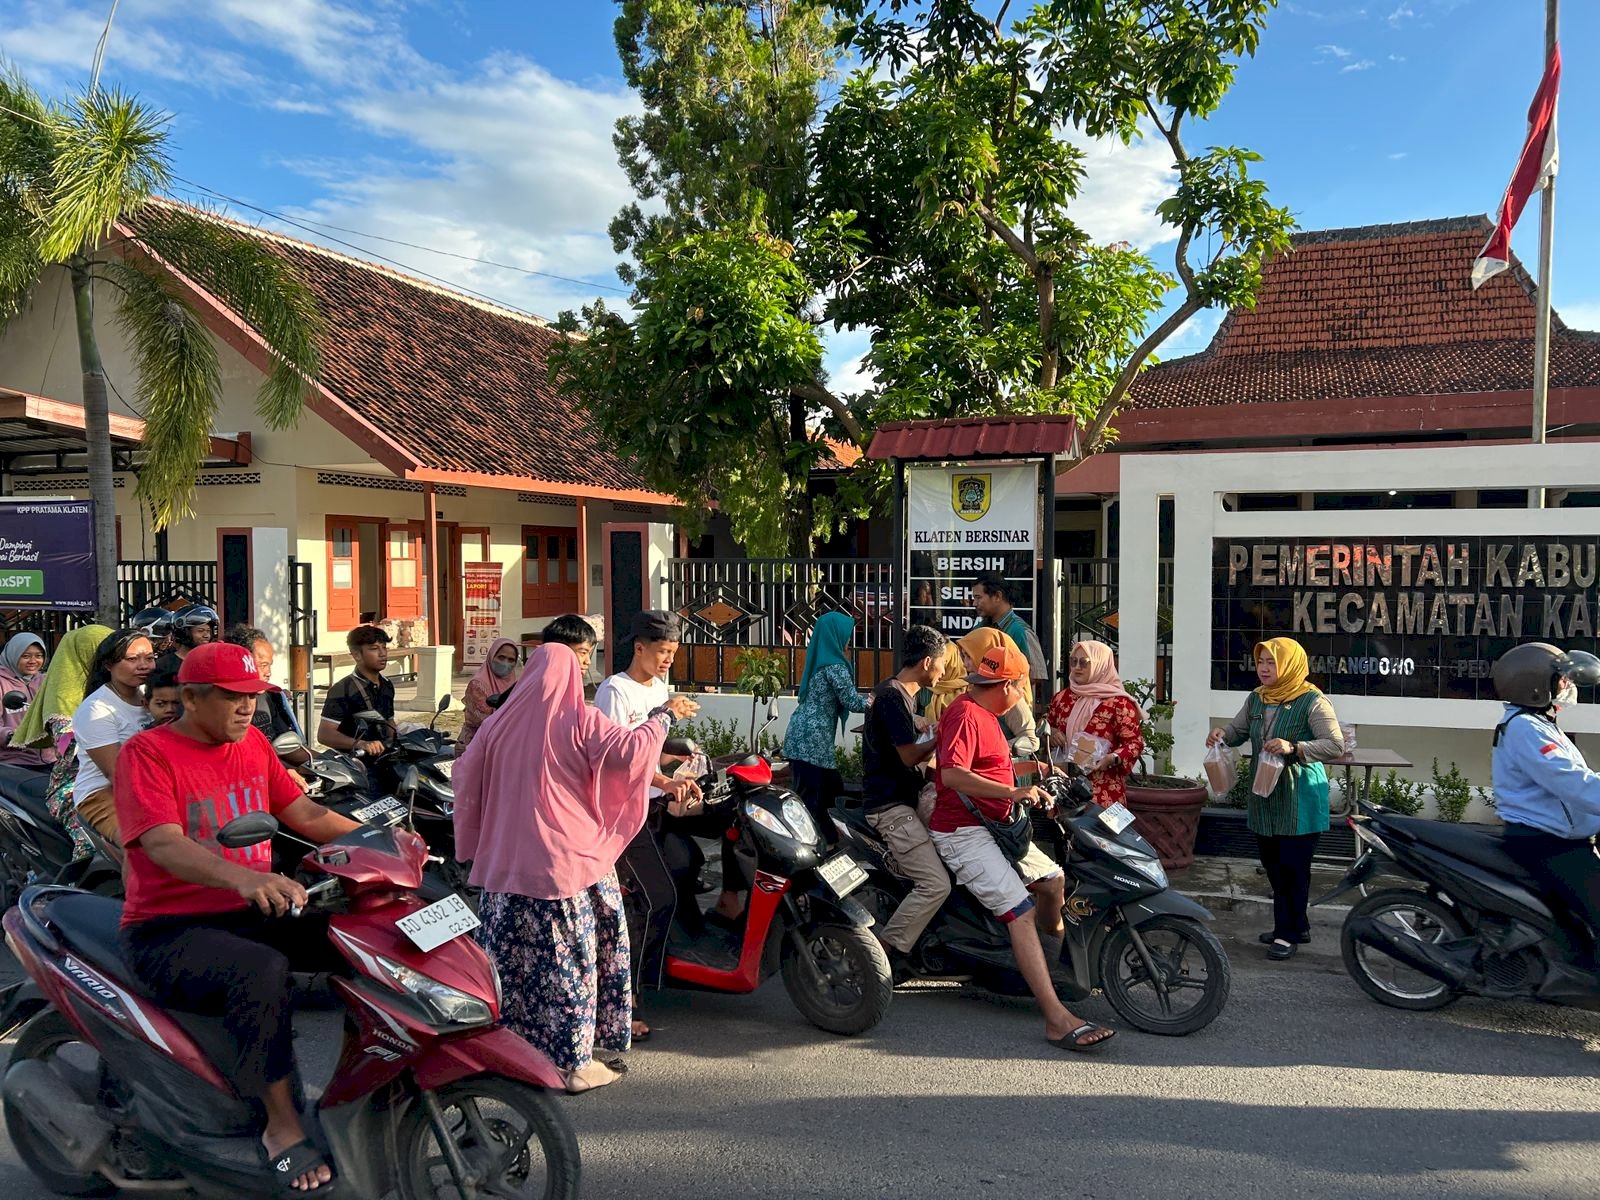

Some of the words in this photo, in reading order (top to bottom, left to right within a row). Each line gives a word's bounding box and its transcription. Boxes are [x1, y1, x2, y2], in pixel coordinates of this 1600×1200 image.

[16, 506, 30, 514] KPP
[31, 506, 62, 514] PRATAMA
[62, 505, 88, 513] KLATEN
[914, 531, 961, 543] KLATEN
[965, 530, 1029, 543] BERSINAR
[0, 537, 33, 552] Dampingi
[937, 557, 1005, 571] BERSIH
[1228, 543, 1470, 587] PEMERINTAH
[940, 586, 975, 600] SEH
[1293, 591, 1524, 638] KECAMATAN
[1542, 594, 1600, 639] KA
[942, 616, 984, 629] INDA
[1457, 659, 1496, 679] PED
[1113, 875, 1140, 888] HONDA
[401, 918, 421, 935] AD
[419, 904, 450, 926] 4362
[447, 897, 465, 913] IB
[372, 1028, 413, 1052] HONDA
